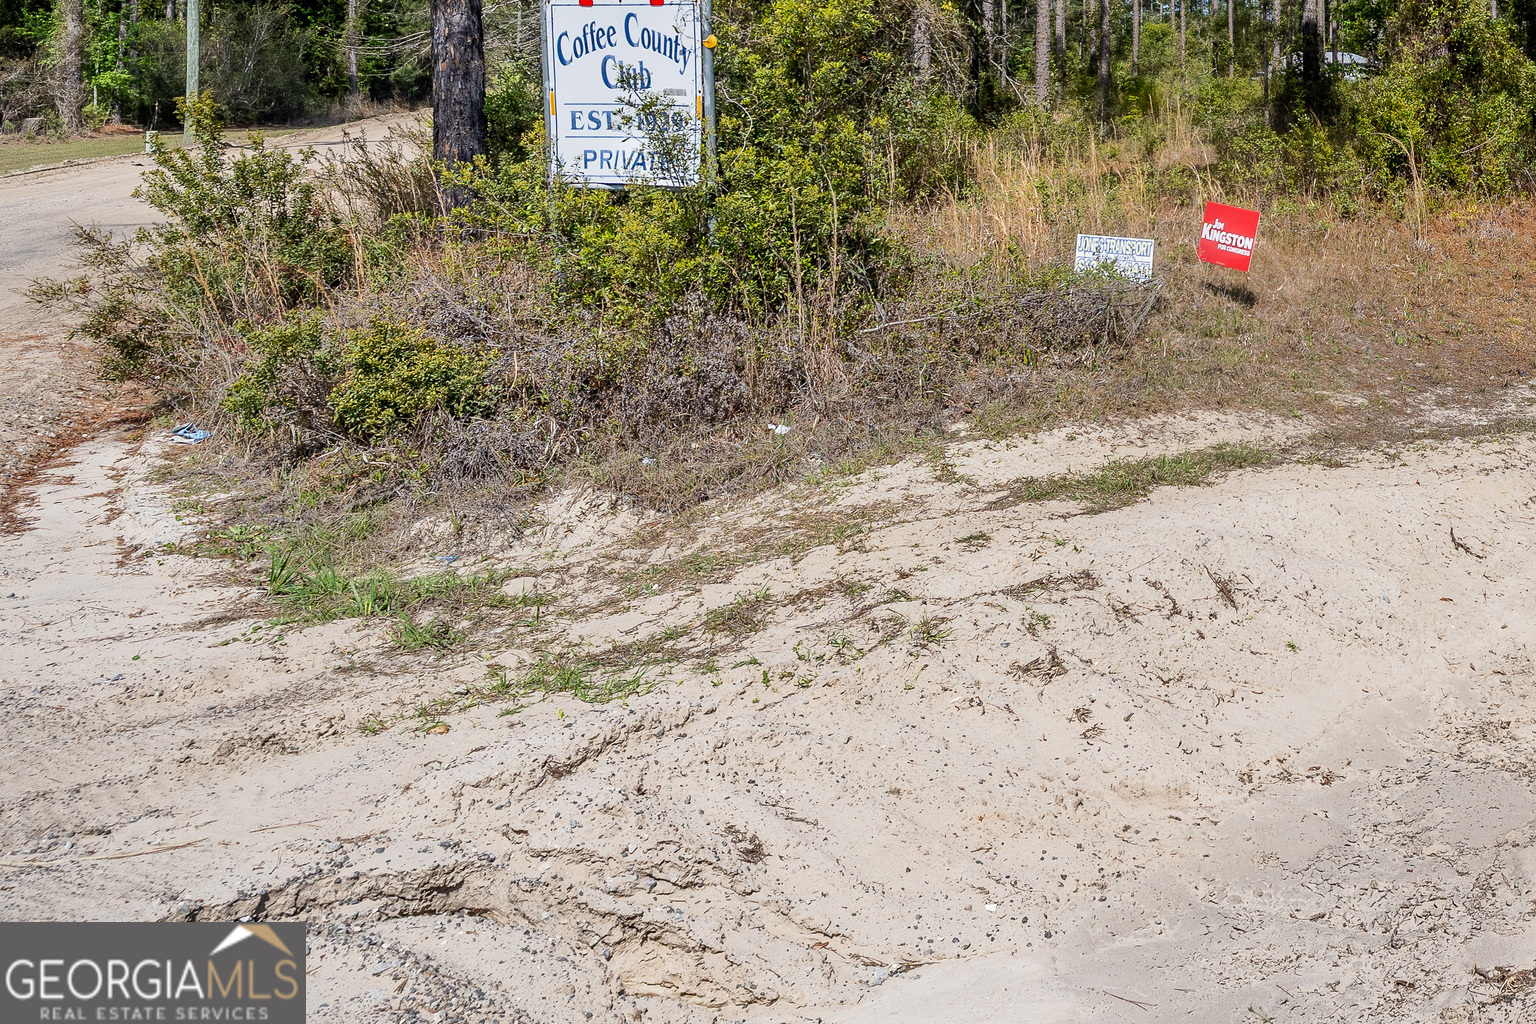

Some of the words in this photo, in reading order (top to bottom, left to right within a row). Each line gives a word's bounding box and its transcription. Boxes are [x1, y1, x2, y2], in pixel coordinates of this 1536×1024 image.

[557, 21, 618, 67] Coffee
[624, 12, 692, 76] County
[601, 54, 652, 91] Club
[1078, 236, 1104, 254] JONES
[1105, 238, 1153, 257] TRANSPORT
[1201, 222, 1254, 250] KINGSTON
